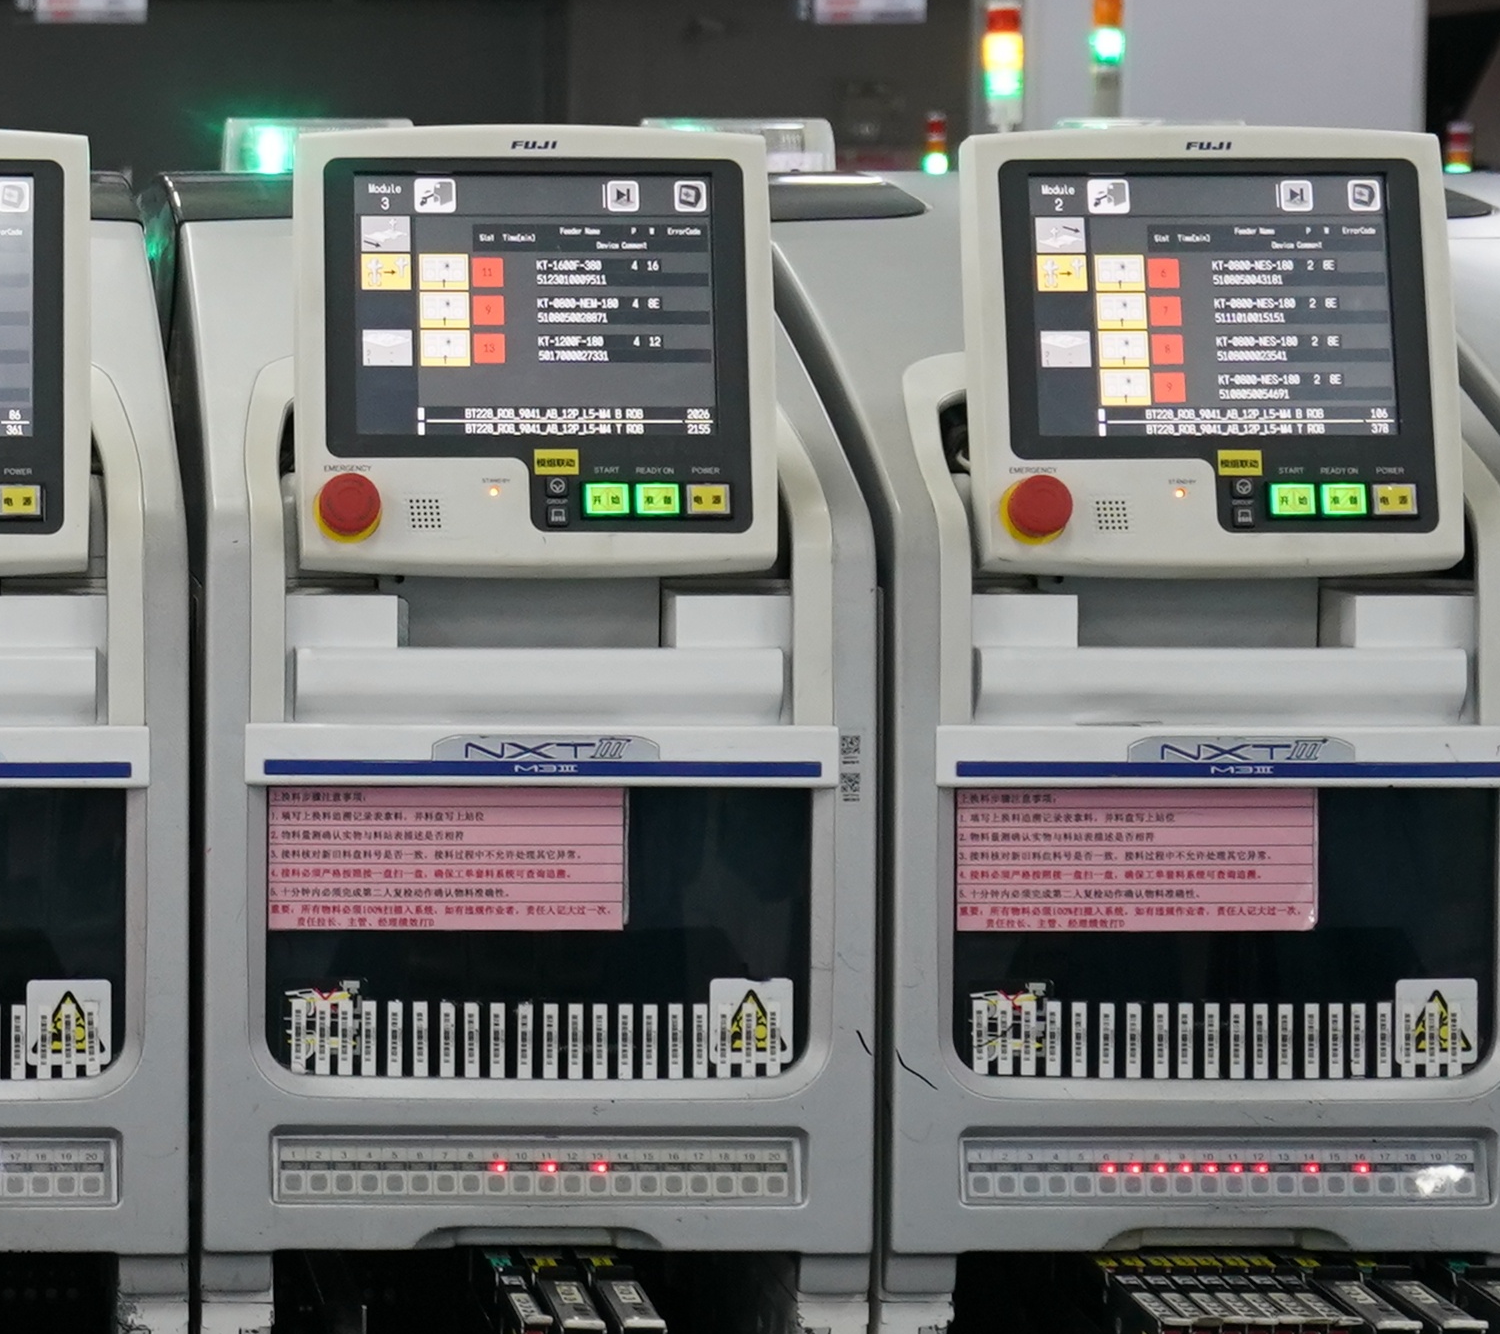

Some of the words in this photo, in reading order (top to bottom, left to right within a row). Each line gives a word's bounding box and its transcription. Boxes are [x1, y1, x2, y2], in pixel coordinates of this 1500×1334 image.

[511, 139, 557, 150] FUJI
[1186, 140, 1232, 150] FUJI
[368, 184, 402, 194] Module
[1042, 185, 1075, 195] Module
[380, 197, 390, 210] 3
[1054, 199, 1064, 211] 2
[4, 467, 33, 475] POWER
[323, 465, 372, 473] EMERGENCY
[594, 466, 620, 475] START
[692, 467, 720, 475] POWER
[1009, 466, 1058, 474] EMERGENCY
[1278, 467, 1305, 475] START
[1376, 467, 1404, 475] POWER
